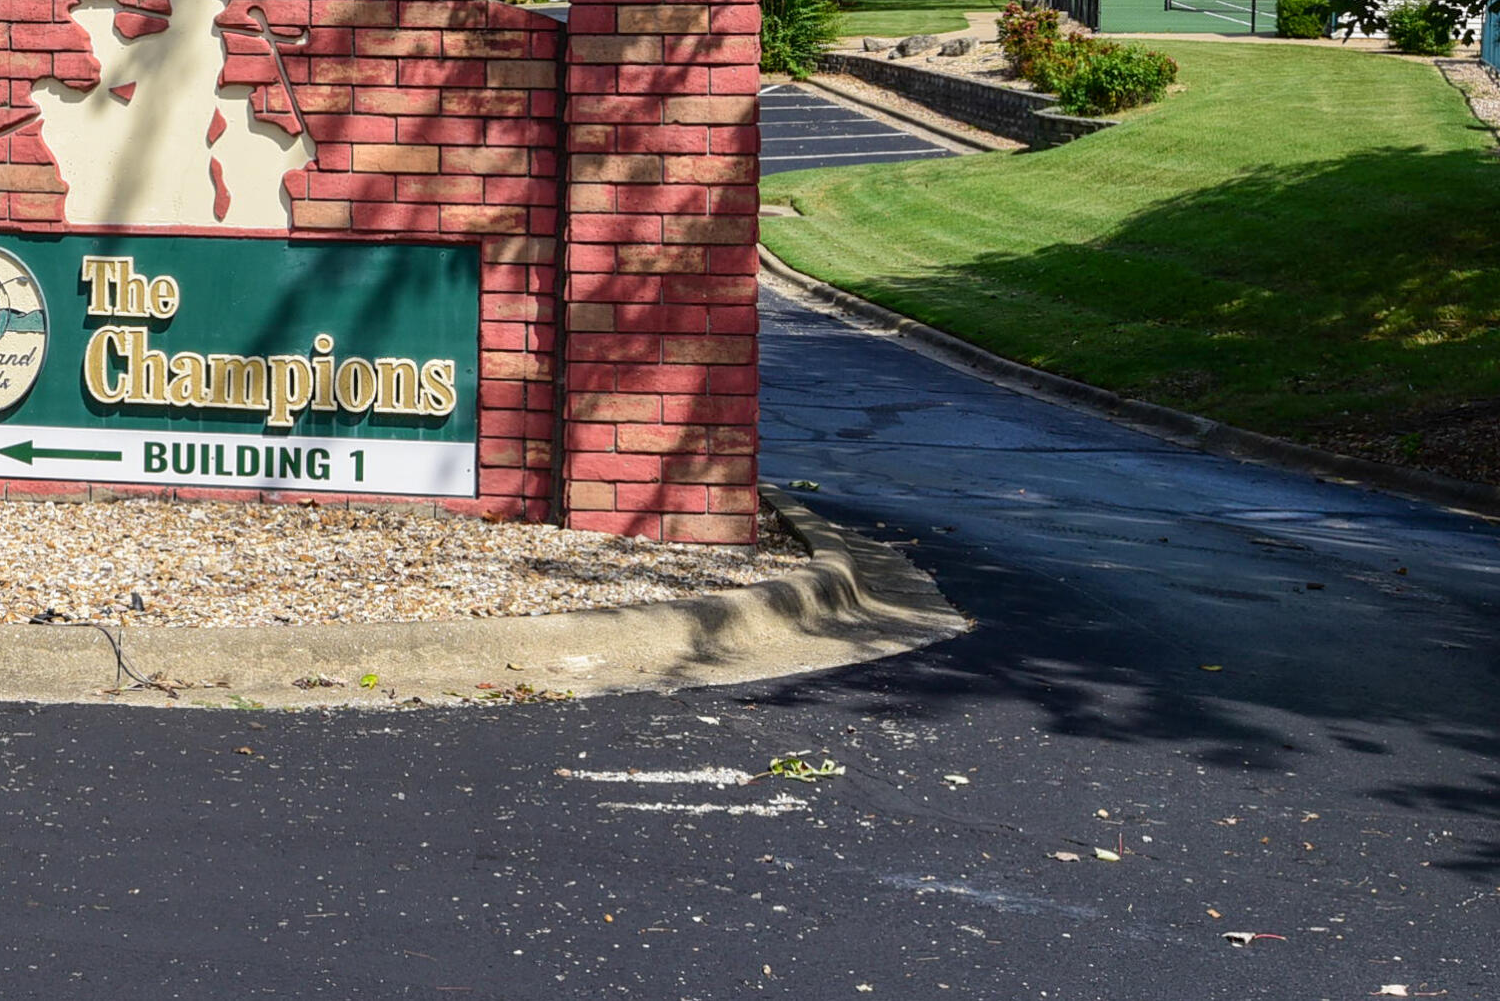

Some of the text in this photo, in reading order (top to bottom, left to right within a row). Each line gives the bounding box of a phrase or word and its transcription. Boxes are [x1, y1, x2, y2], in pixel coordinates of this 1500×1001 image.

[82, 255, 180, 318] The
[85, 326, 456, 427] Champions
[144, 441, 365, 481] BUILDING 1
